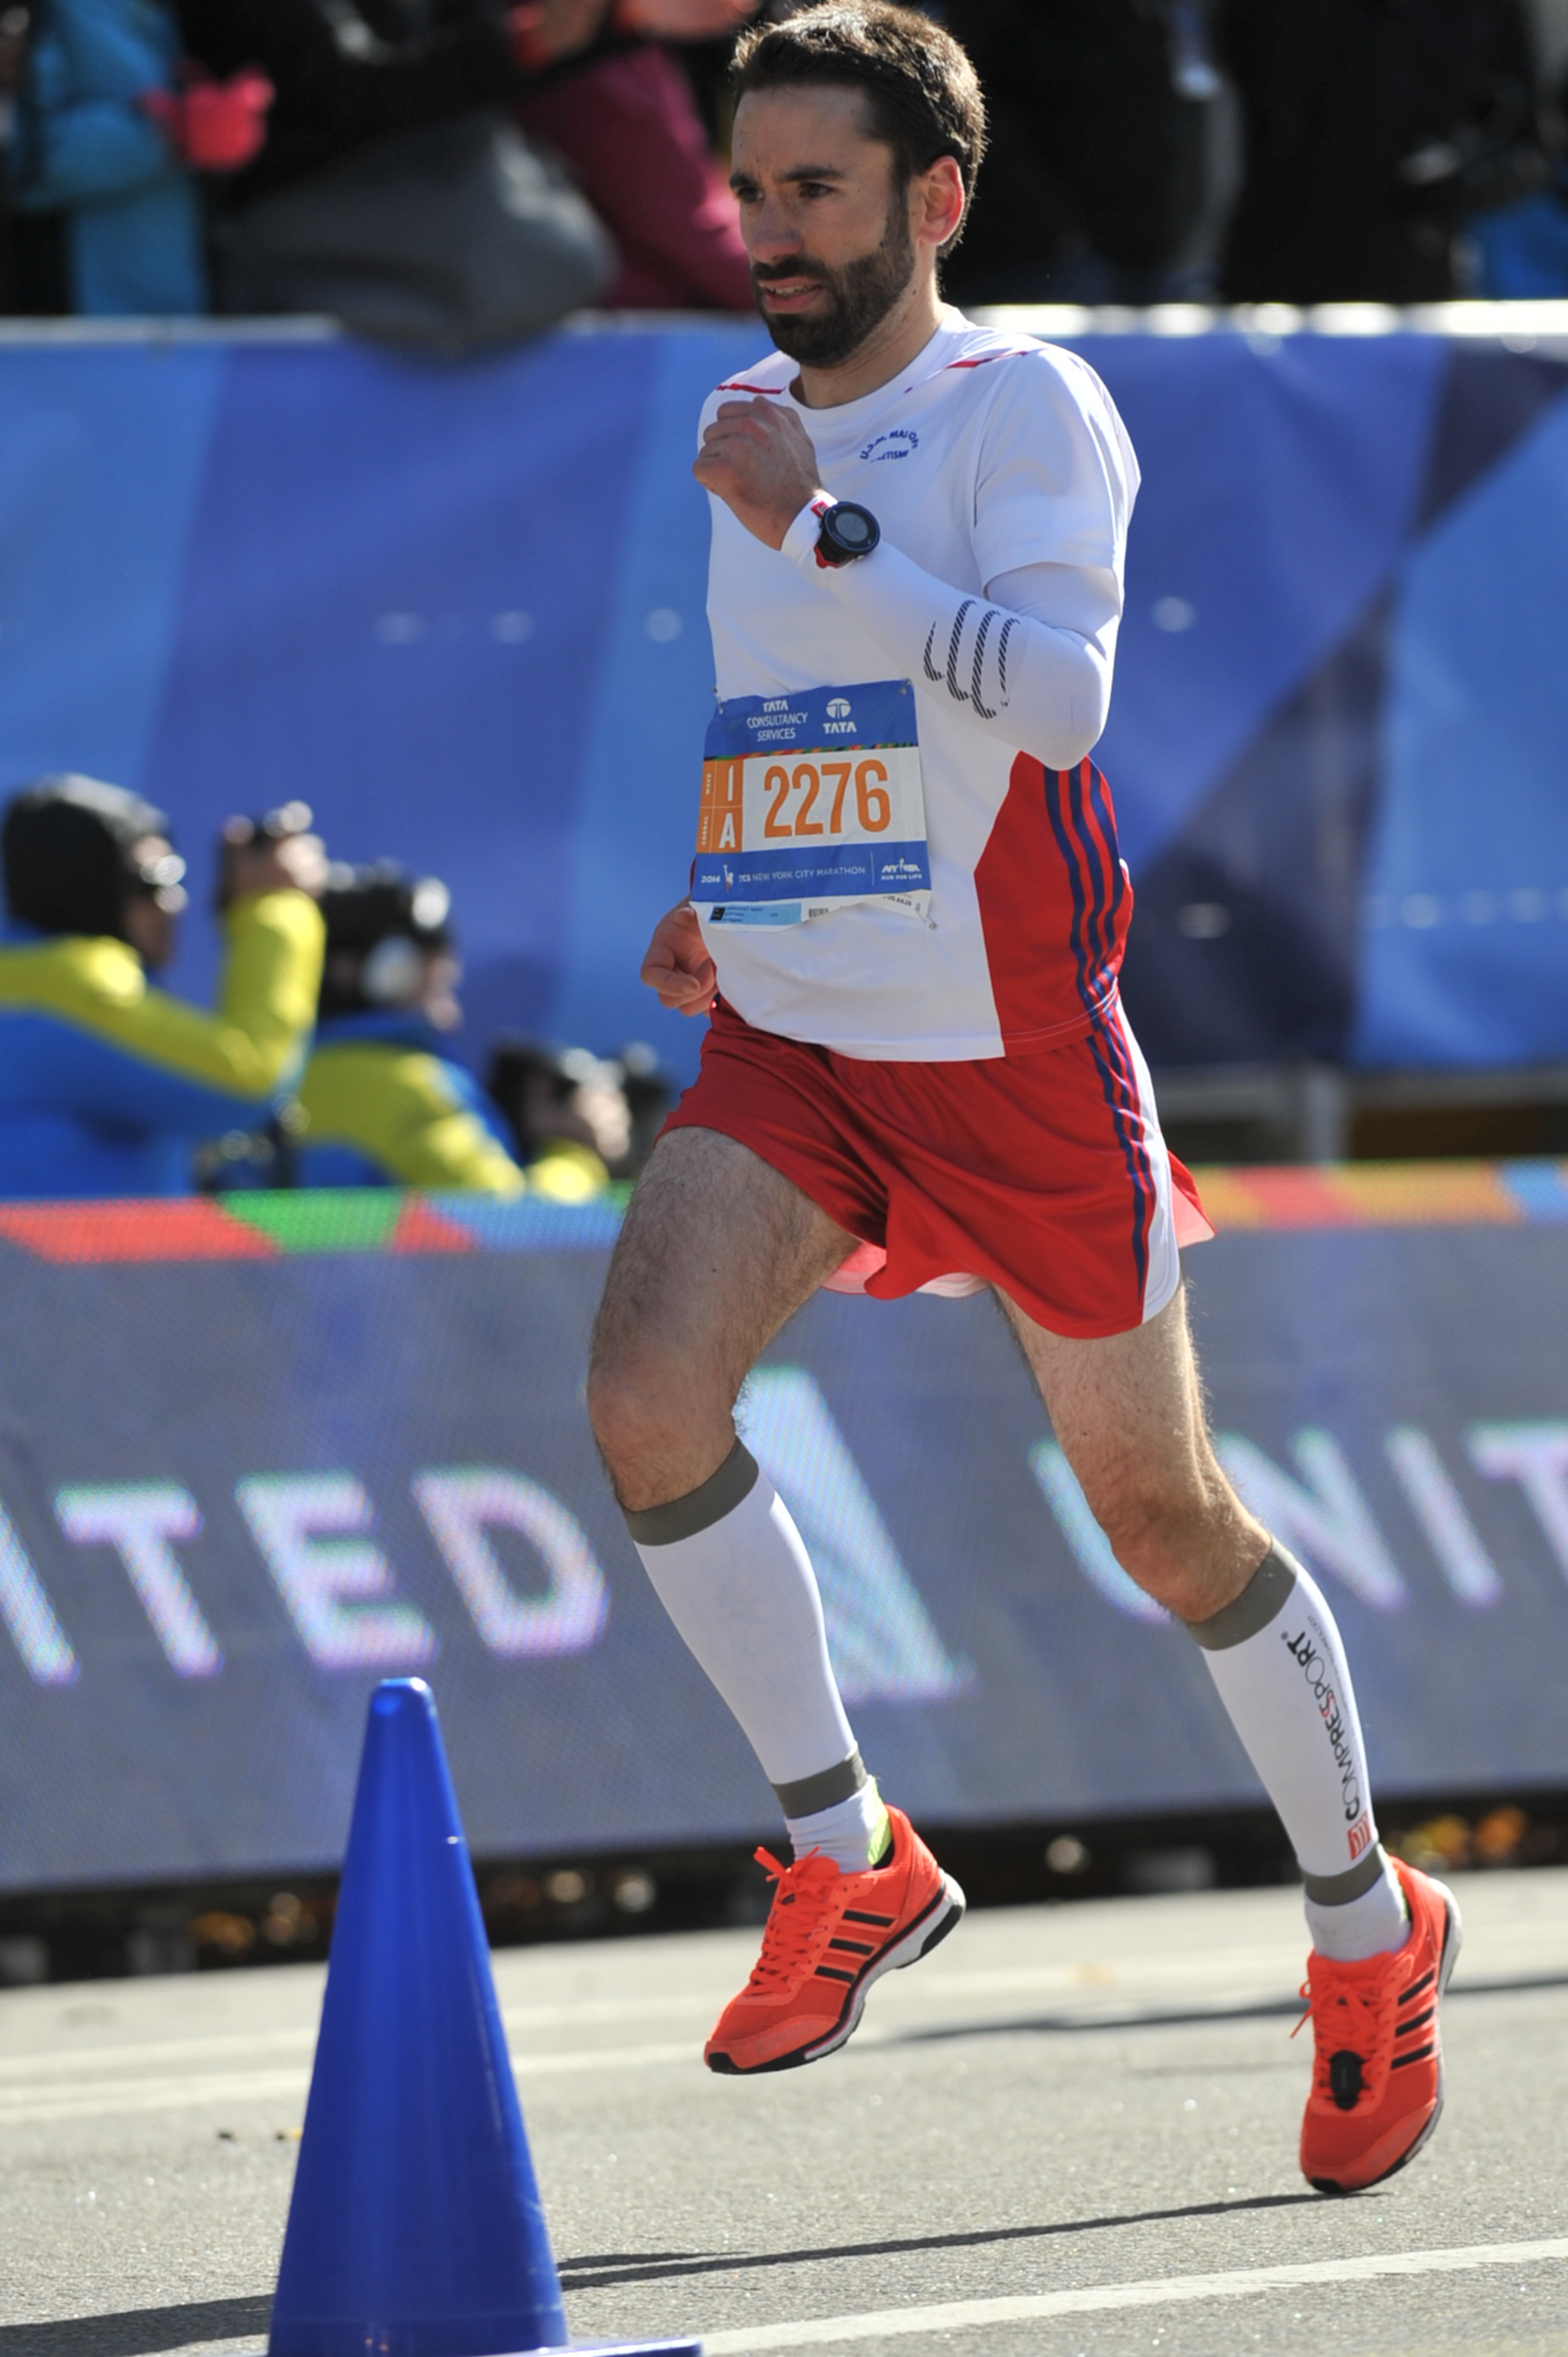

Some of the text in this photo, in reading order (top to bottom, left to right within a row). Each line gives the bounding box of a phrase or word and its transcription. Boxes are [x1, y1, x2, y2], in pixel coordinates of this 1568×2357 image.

[763, 699, 789, 712] TATA
[746, 712, 809, 729] CONSULTANCY
[822, 721, 858, 735] TATA
[756, 727, 796, 742] SERVICES
[763, 759, 891, 838] 2276
[718, 812, 736, 849] A
[701, 875, 721, 884] 2014
[752, 873, 770, 881] NEW
[771, 870, 793, 880] YORK
[794, 869, 814, 879] CITY
[816, 866, 866, 877] MARATHON
